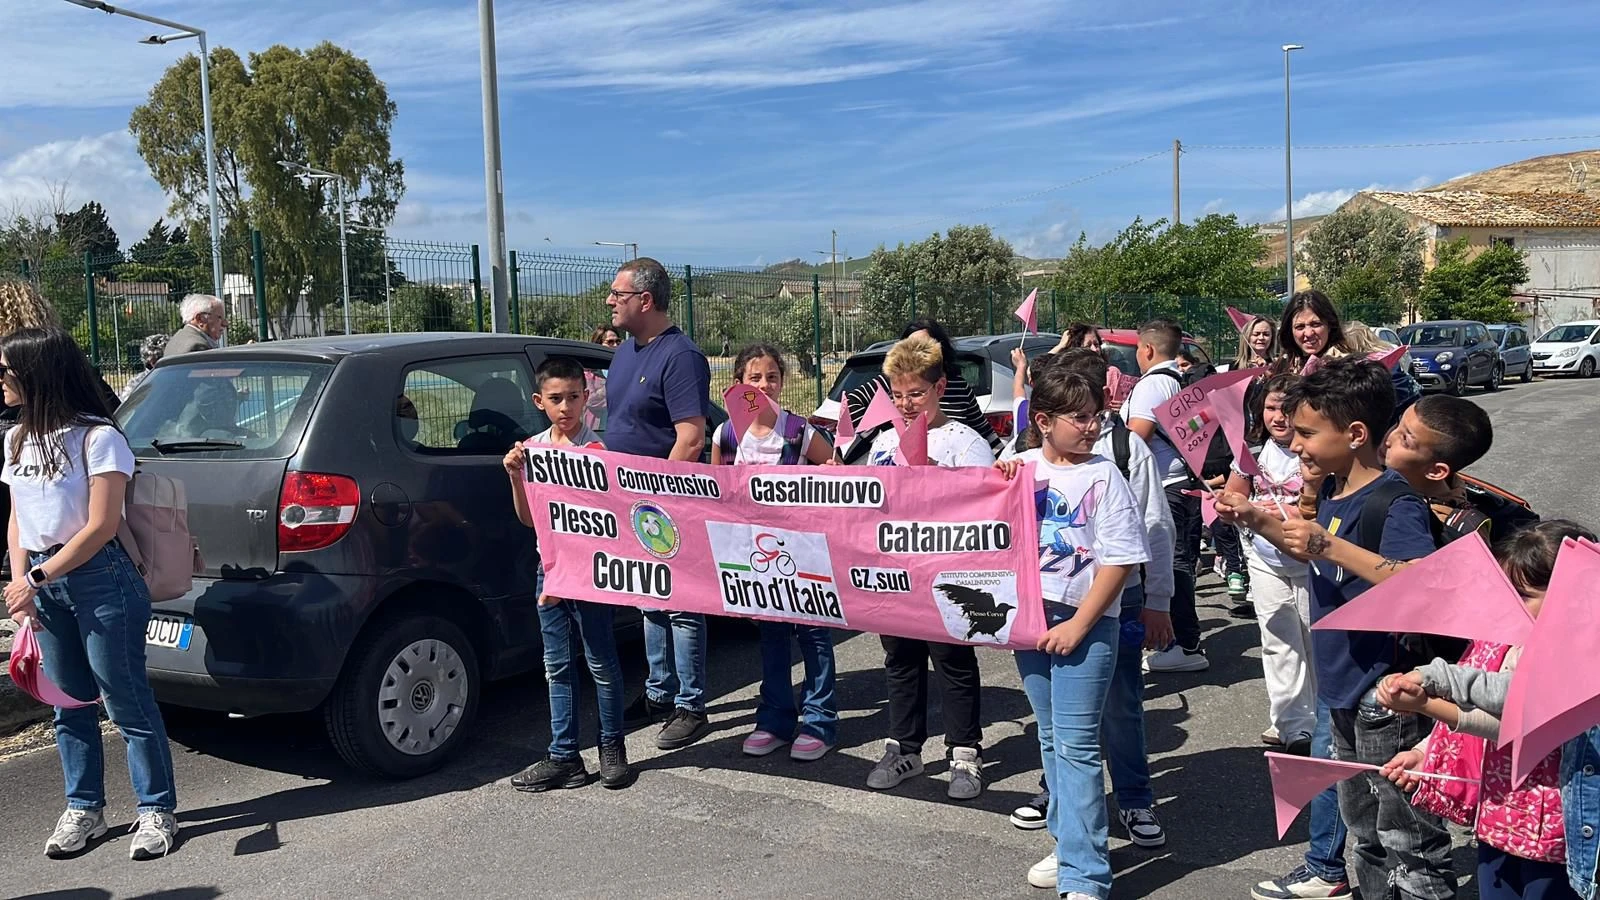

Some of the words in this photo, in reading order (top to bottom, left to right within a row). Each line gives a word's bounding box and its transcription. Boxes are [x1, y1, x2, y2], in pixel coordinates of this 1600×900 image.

[1169, 386, 1205, 418] GIRO
[1187, 431, 1209, 452] 2026
[525, 448, 609, 492] Istituto
[617, 466, 720, 498] Comprensivo
[750, 476, 882, 504] Casalinuovo
[246, 509, 268, 521] TDI
[549, 502, 618, 538] Plesso
[878, 522, 1010, 552] Catanzaro
[593, 551, 672, 597] Corvo
[721, 570, 767, 609] Giro
[768, 579, 842, 619] d'Italia
[146, 616, 180, 643] 0CD
